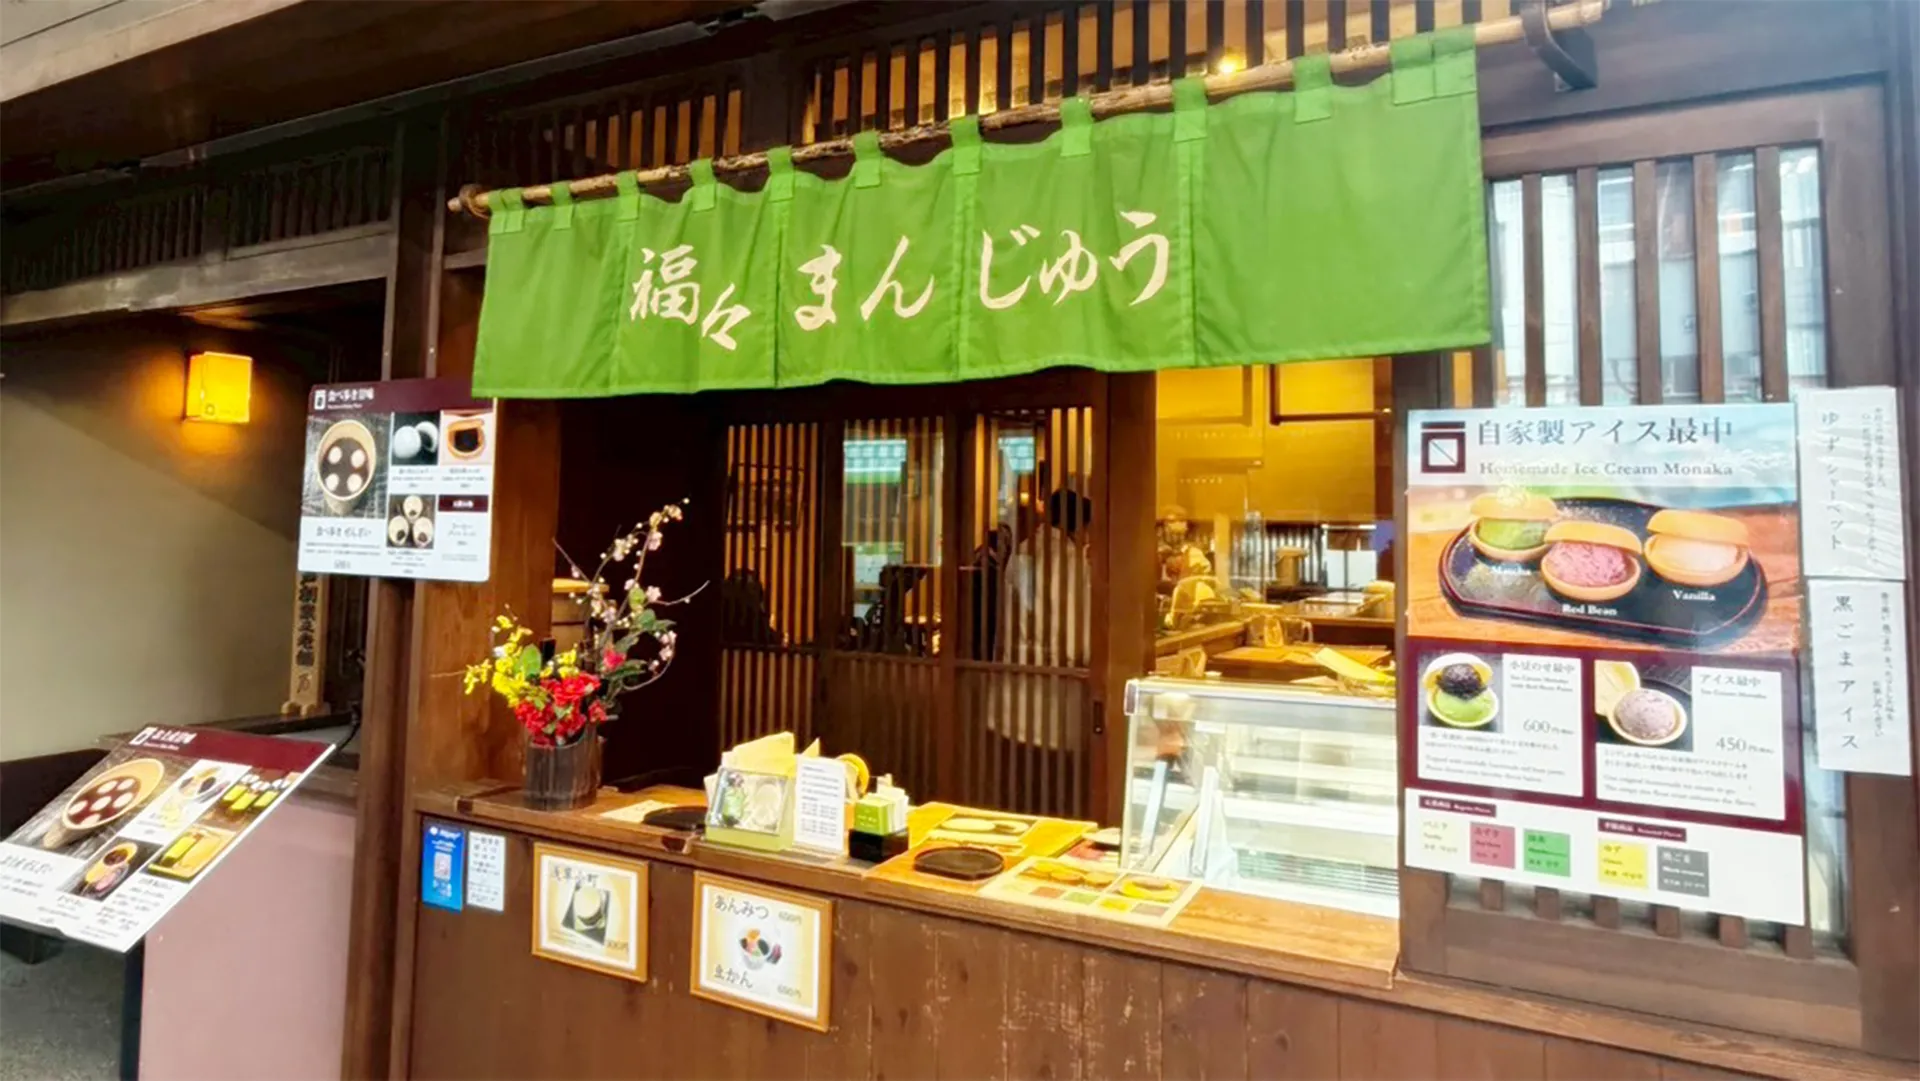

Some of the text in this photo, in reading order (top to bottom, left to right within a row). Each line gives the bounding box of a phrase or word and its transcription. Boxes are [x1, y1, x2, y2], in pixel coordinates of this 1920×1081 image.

[630, 210, 1171, 351] 福々まんじゅう
[1478, 416, 1732, 445] 自家製アイス最中
[1479, 462, 1733, 477] Homemade Ice Cream Monaka
[1822, 412, 1845, 550] ゆずシャーベット
[1672, 589, 1717, 602] Vanilla
[1562, 604, 1617, 617] Red Bean
[1699, 673, 1762, 688] アイス最中
[1833, 595, 1859, 750] 黒ごまアイス
[1716, 736, 1746, 751] 450
[714, 894, 769, 920] あんみつ
